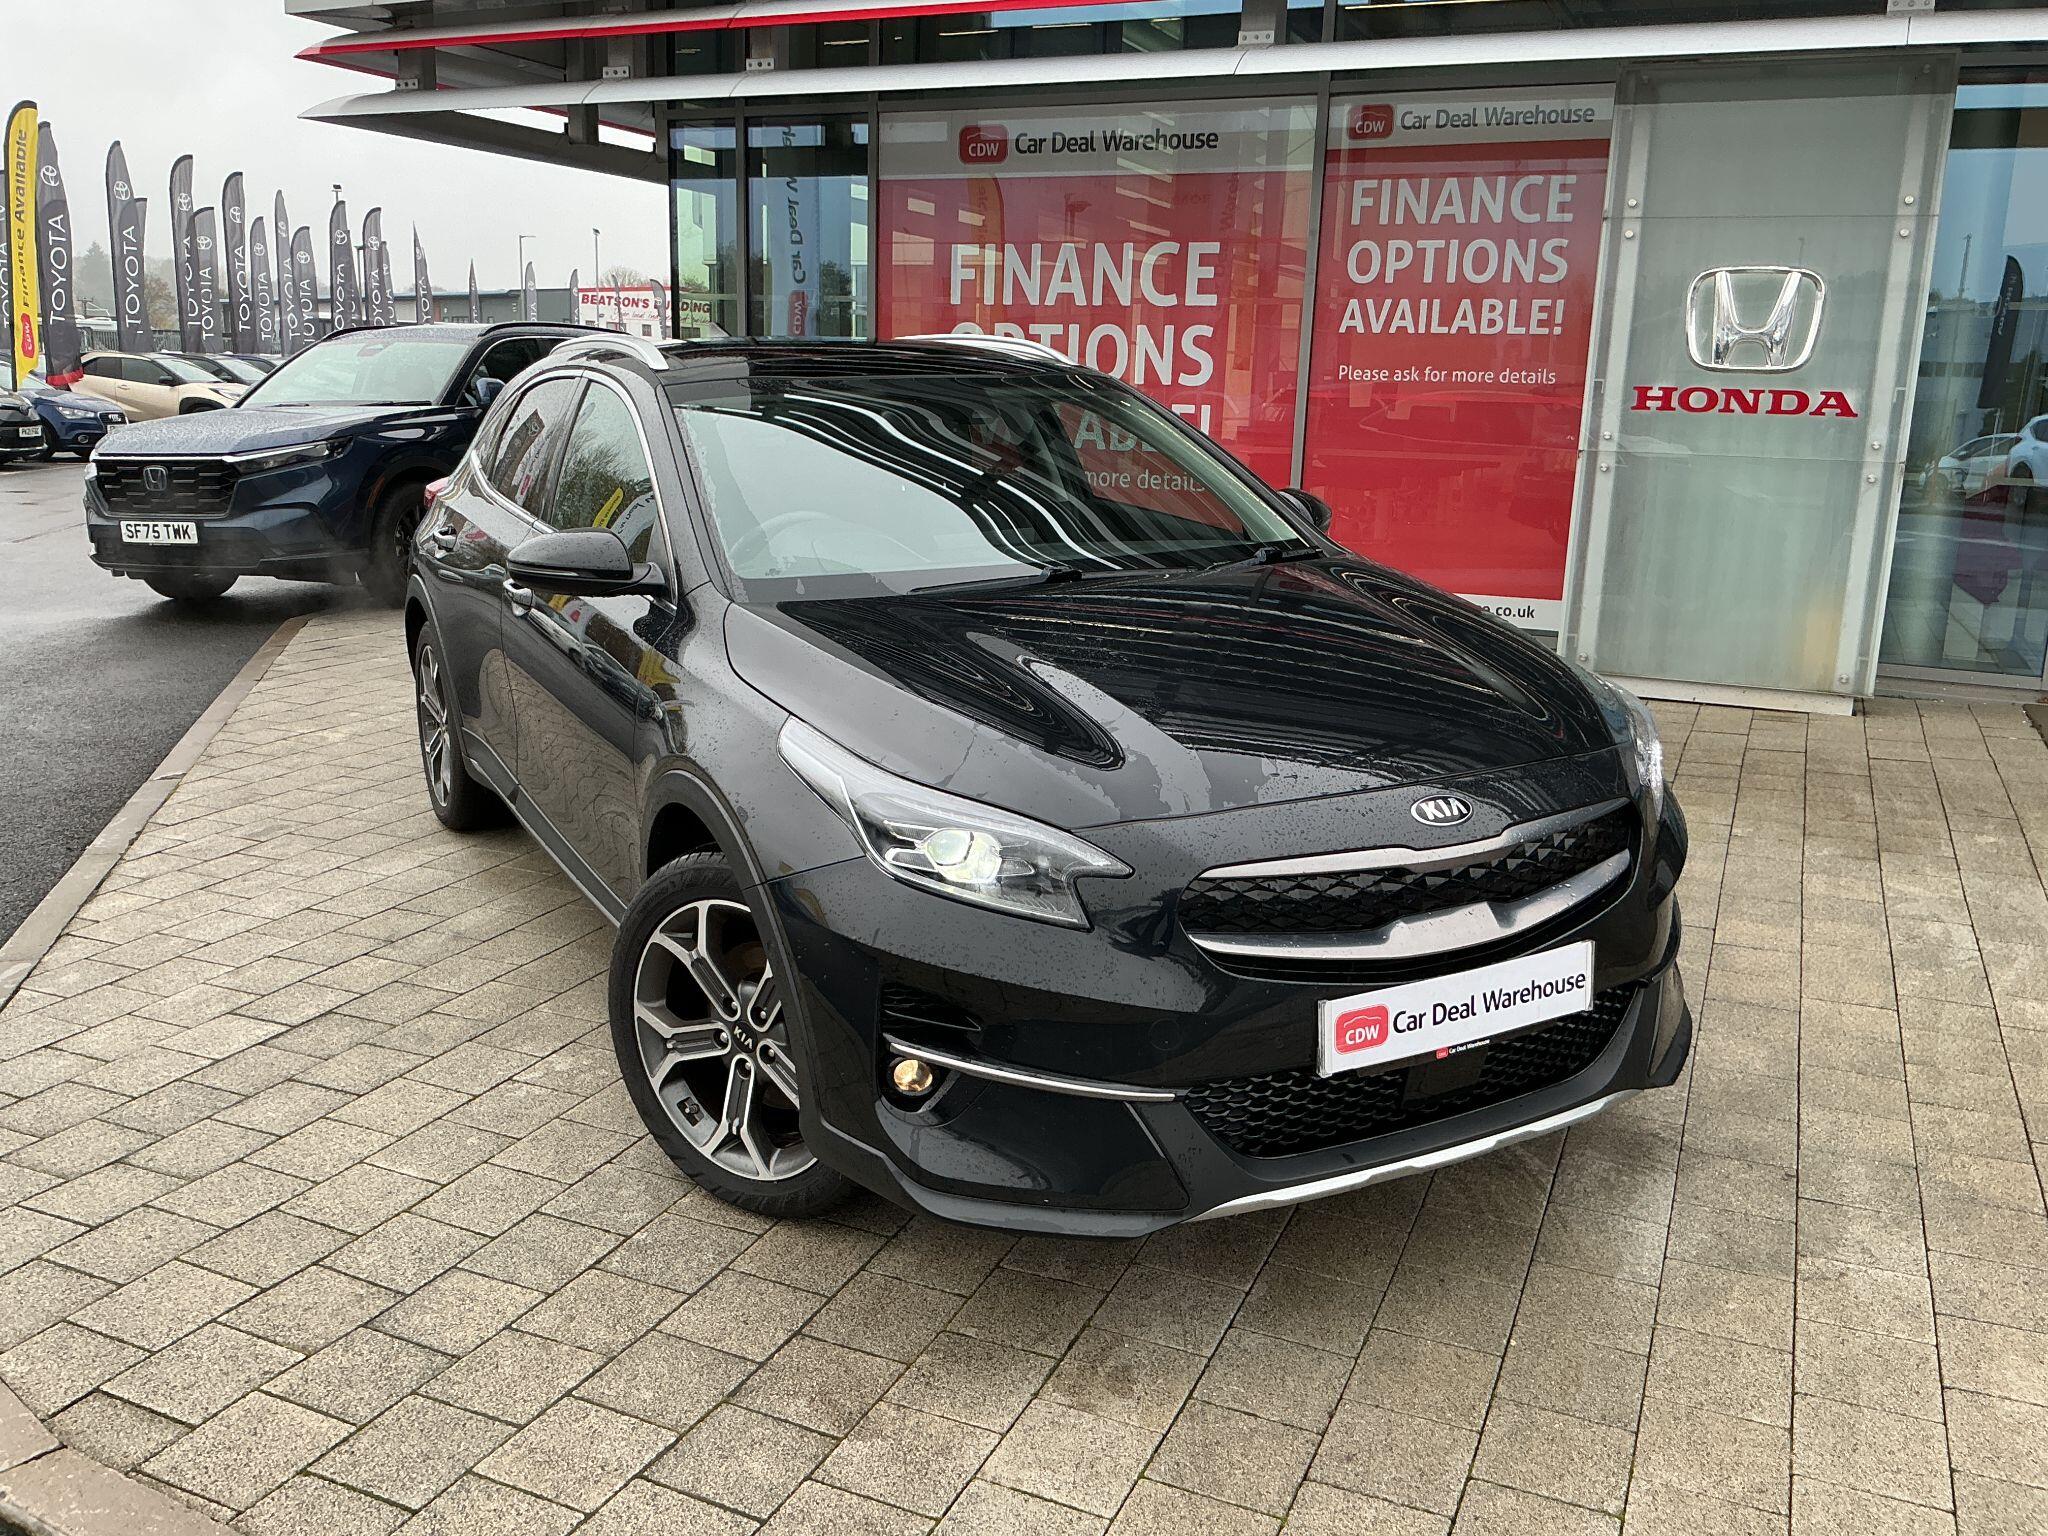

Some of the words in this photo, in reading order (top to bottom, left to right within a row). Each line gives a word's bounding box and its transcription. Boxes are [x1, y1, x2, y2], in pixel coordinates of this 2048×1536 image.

[1355, 120, 1385, 134] CDW
[1400, 111, 1431, 130] Car
[1435, 107, 1478, 129] Deal
[1484, 104, 1595, 126] Warehouse
[968, 142, 999, 157] CDW
[1015, 133, 1047, 155] Car
[1052, 130, 1096, 154] Deal
[1102, 128, 1219, 151] Warehouse
[14, 129, 27, 223] Available
[1351, 174, 1577, 225] FINANCE
[48, 213, 68, 325] TOYOTA
[123, 225, 142, 328] TOYOTA
[950, 241, 1221, 307] FINANCE
[1346, 238, 1569, 284] OPTIONS
[234, 245, 251, 333] TOYOTA
[258, 272, 272, 341] TOYOTA
[580, 293, 650, 309] BEATSON'S
[1338, 298, 1565, 335] AVAILABLE!
[1338, 365, 1389, 381] Please
[1393, 365, 1420, 382] ask
[1424, 366, 1448, 382] for
[1452, 369, 1494, 383] more
[1499, 368, 1556, 384] details
[1630, 385, 1860, 418] HONDA
[125, 523, 161, 540] SF75
[163, 523, 192, 540] TWK
[1419, 797, 1468, 820] KIA
[1345, 1023, 1380, 1045] CDW
[1392, 1010, 1426, 1034] Car
[1432, 999, 1477, 1027] Deal
[1483, 972, 1586, 1013] Warehouse
[733, 1025, 753, 1050] KIA
